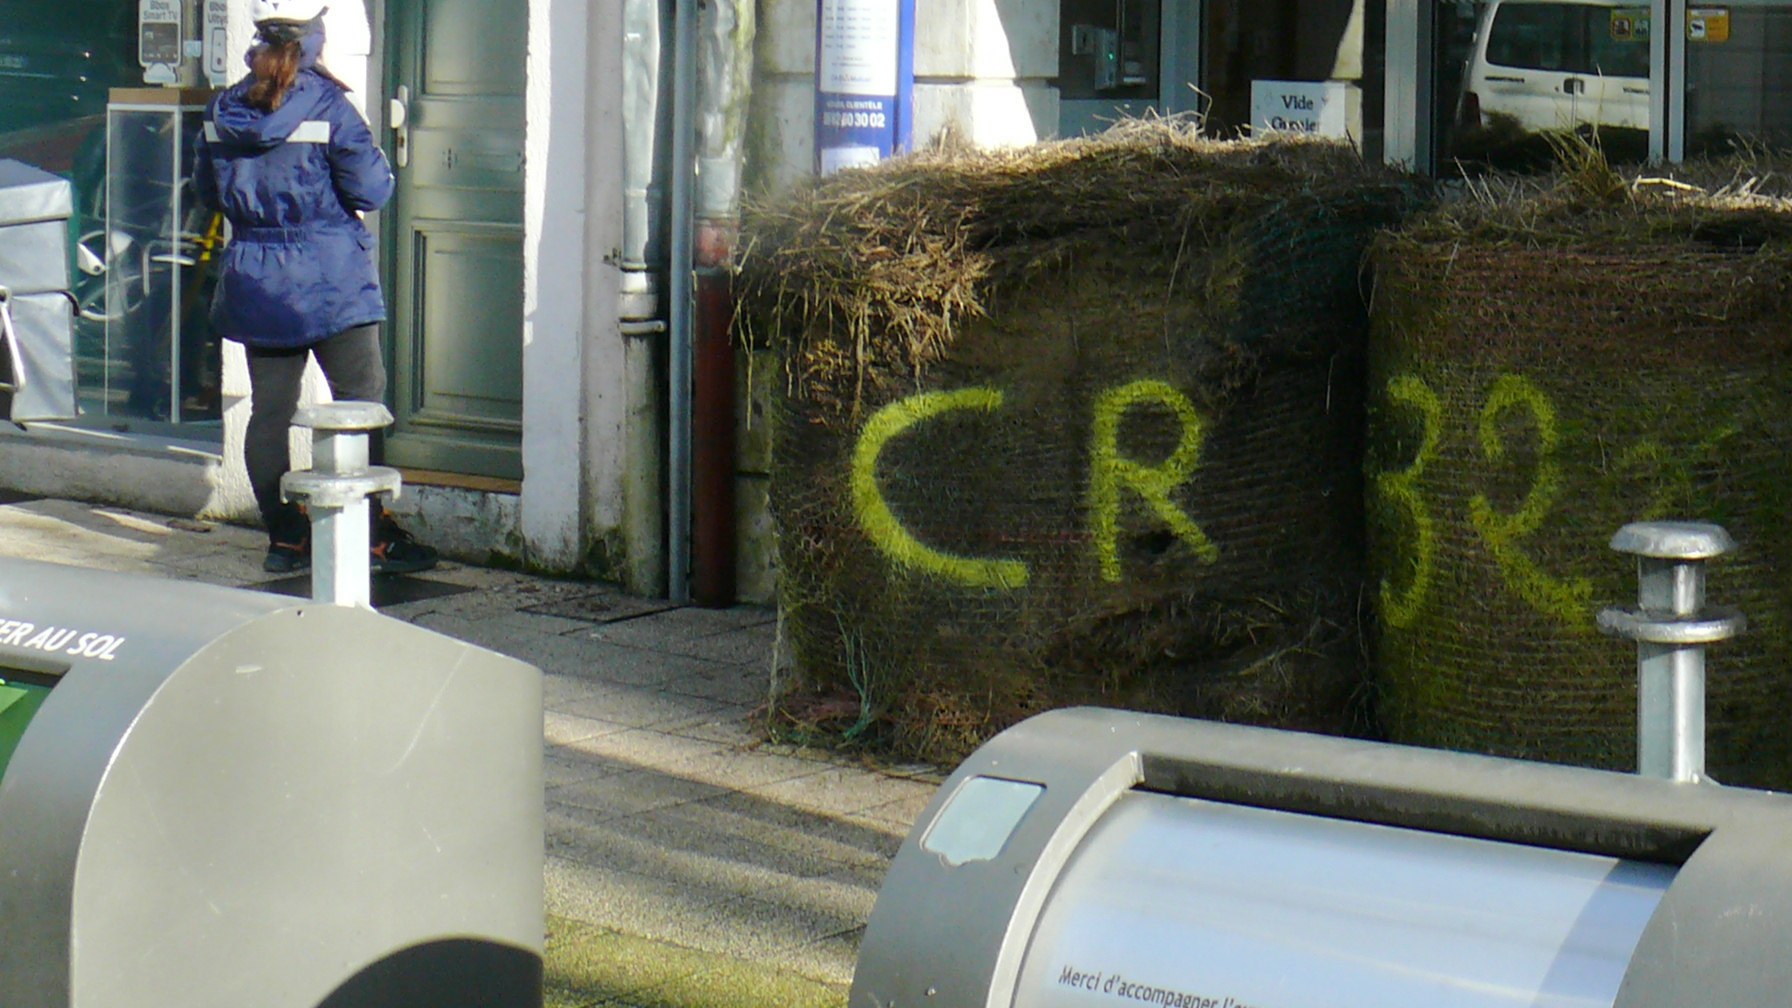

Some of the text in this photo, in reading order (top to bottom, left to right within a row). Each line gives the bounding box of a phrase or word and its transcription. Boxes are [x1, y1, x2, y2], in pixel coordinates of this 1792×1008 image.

[208, 0, 227, 12] Bbo
[0, 618, 126, 661] ER AU SOL
[1058, 964, 1102, 990] Merci
